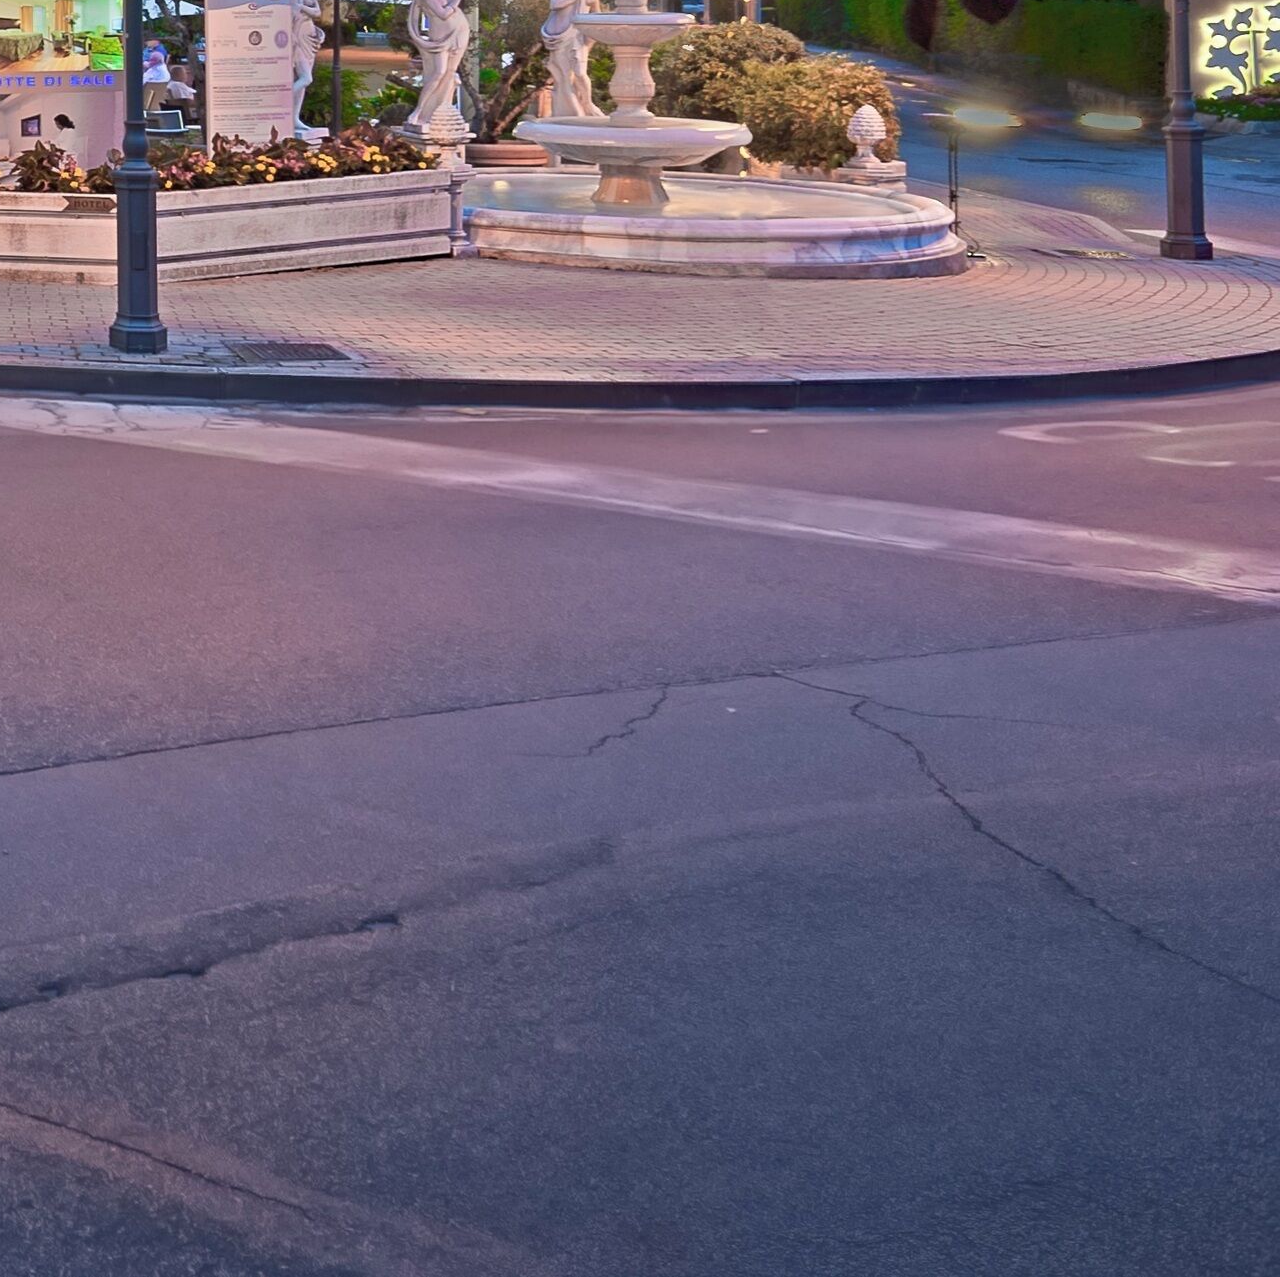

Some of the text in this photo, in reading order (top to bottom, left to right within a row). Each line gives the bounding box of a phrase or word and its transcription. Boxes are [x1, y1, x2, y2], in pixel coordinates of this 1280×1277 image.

[44, 76, 62, 87] DI
[70, 74, 115, 86] SALE
[73, 200, 110, 209] HOTEL
